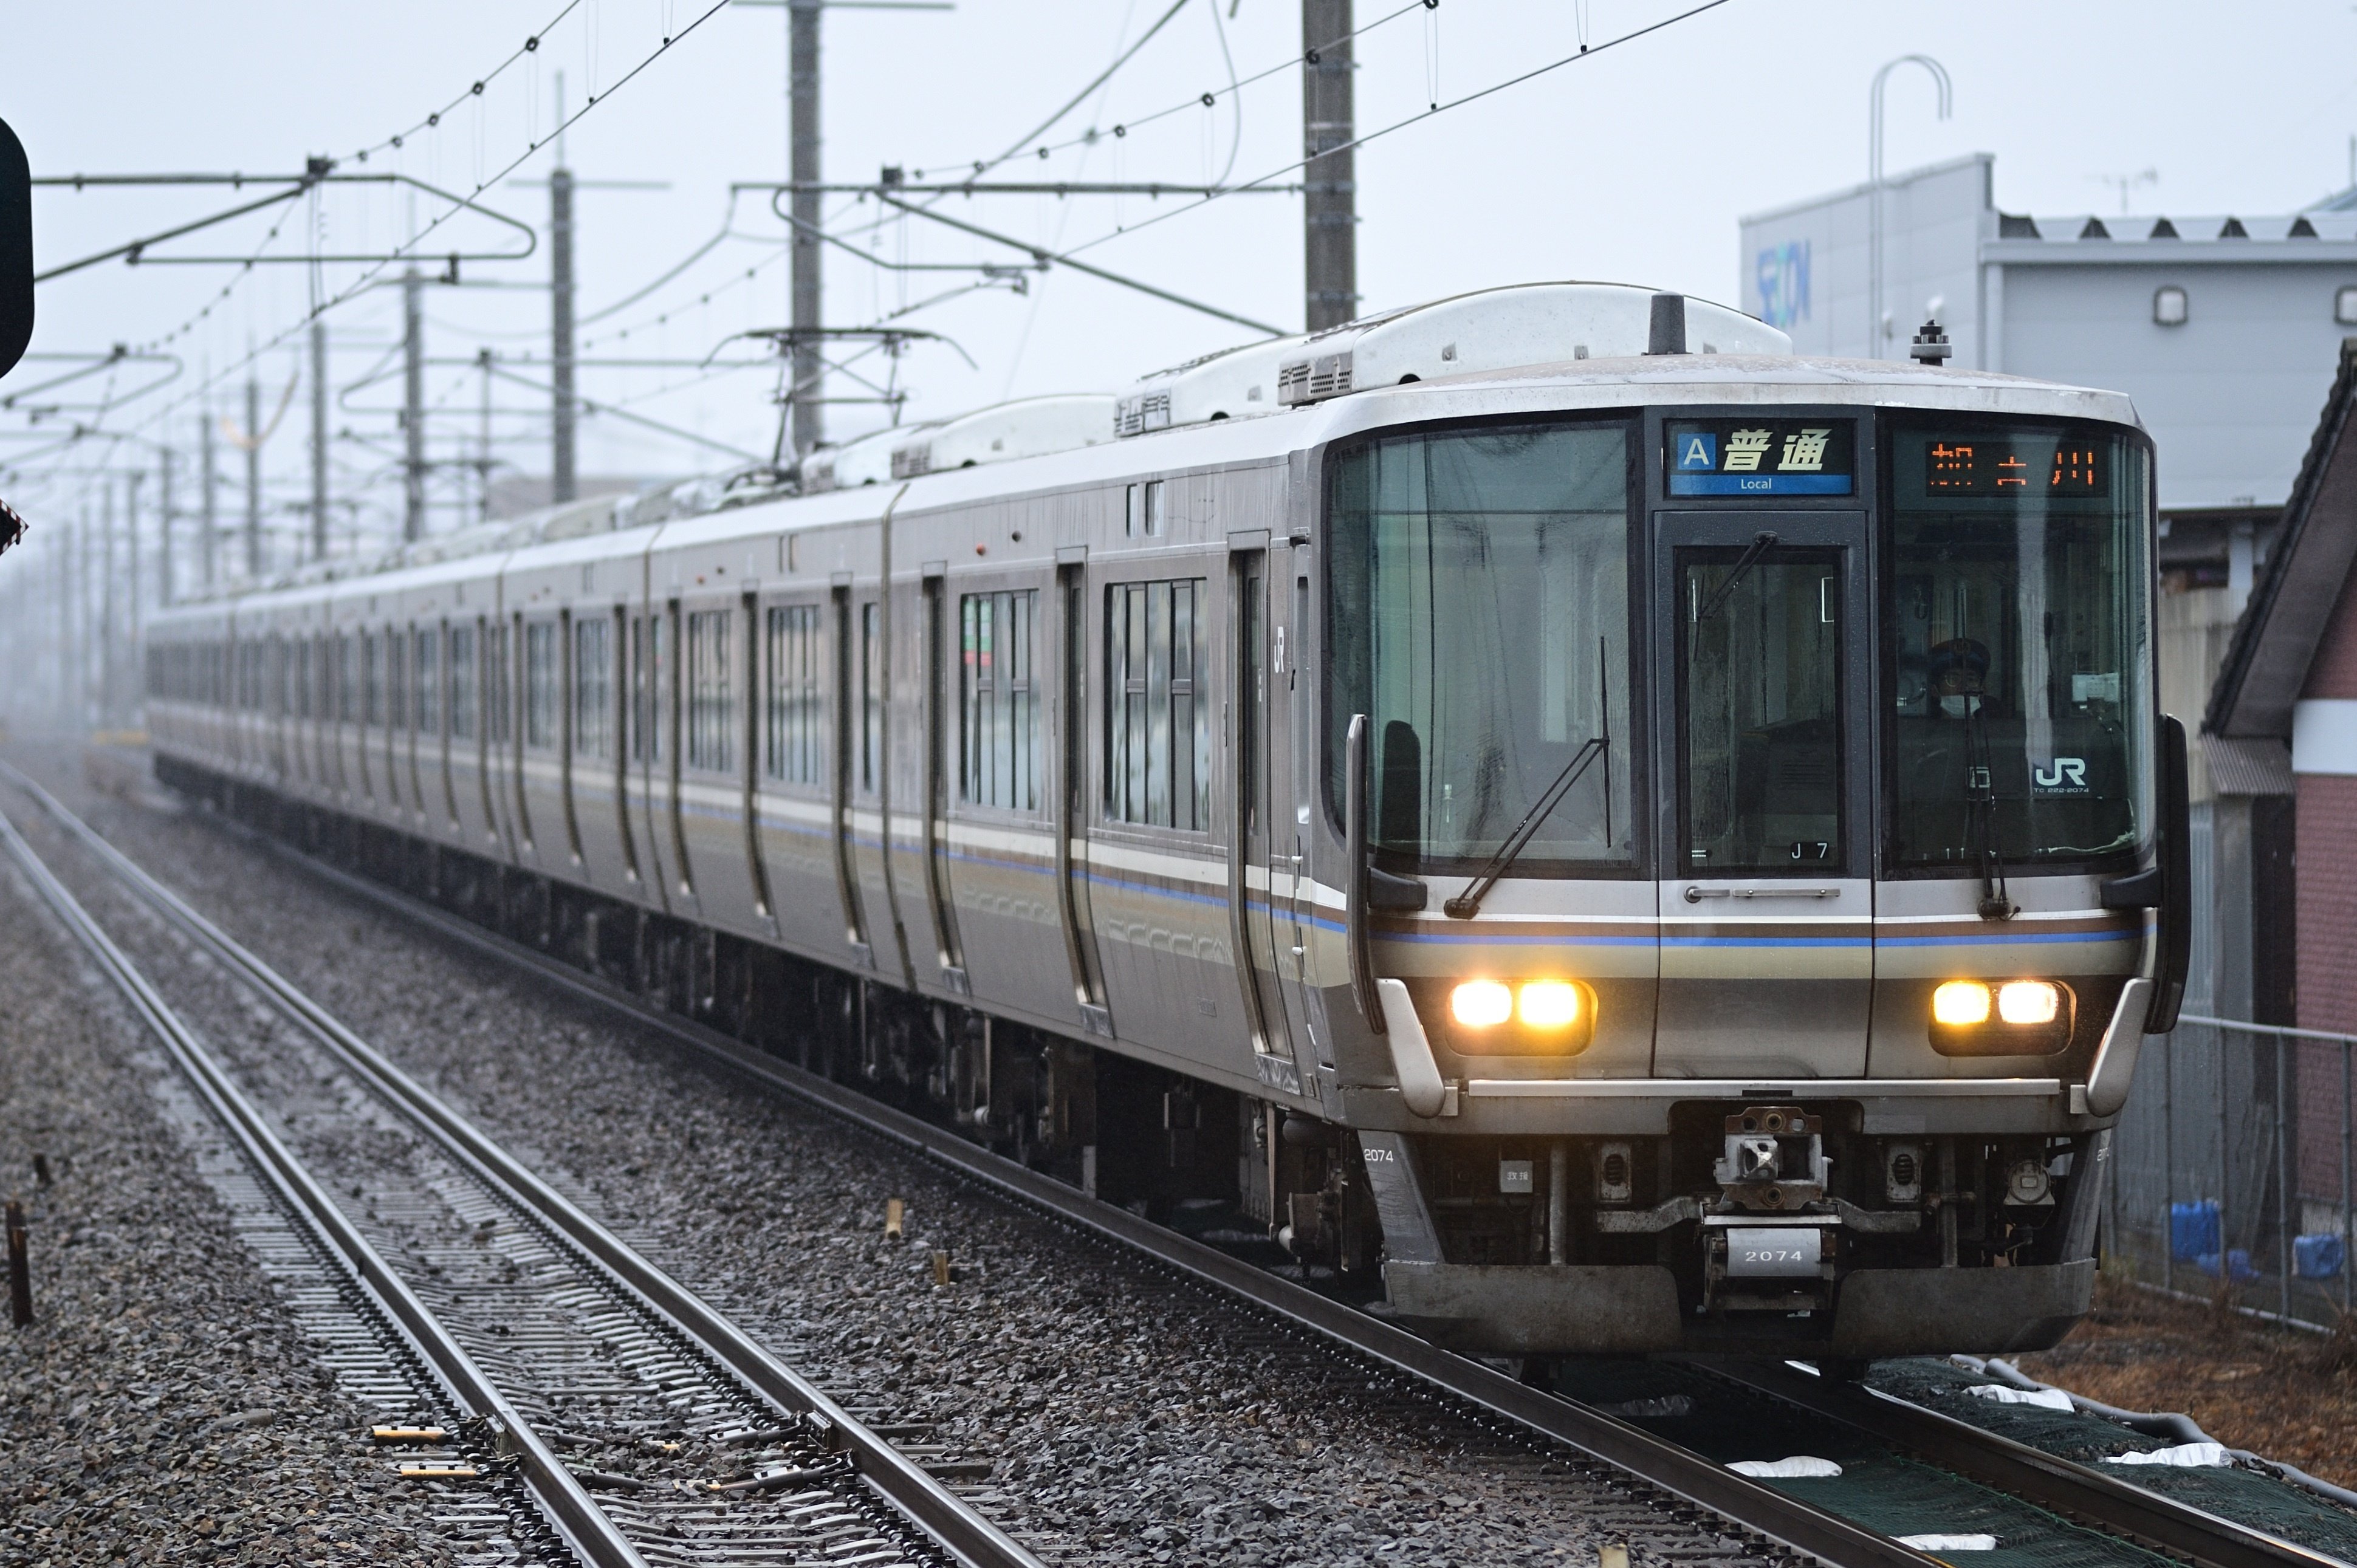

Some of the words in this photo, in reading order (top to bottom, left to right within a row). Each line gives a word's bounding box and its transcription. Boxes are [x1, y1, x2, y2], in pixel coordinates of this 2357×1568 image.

[1683, 438, 1710, 465] A
[1723, 429, 1832, 471] 普通
[1741, 478, 1772, 490] Local
[1274, 626, 1285, 673] JR
[2036, 758, 2086, 786] JR
[1791, 843, 1801, 859] J
[1817, 842, 1828, 858] 7
[1364, 1149, 1393, 1162] 2074
[1745, 1250, 1803, 1262] 2074
